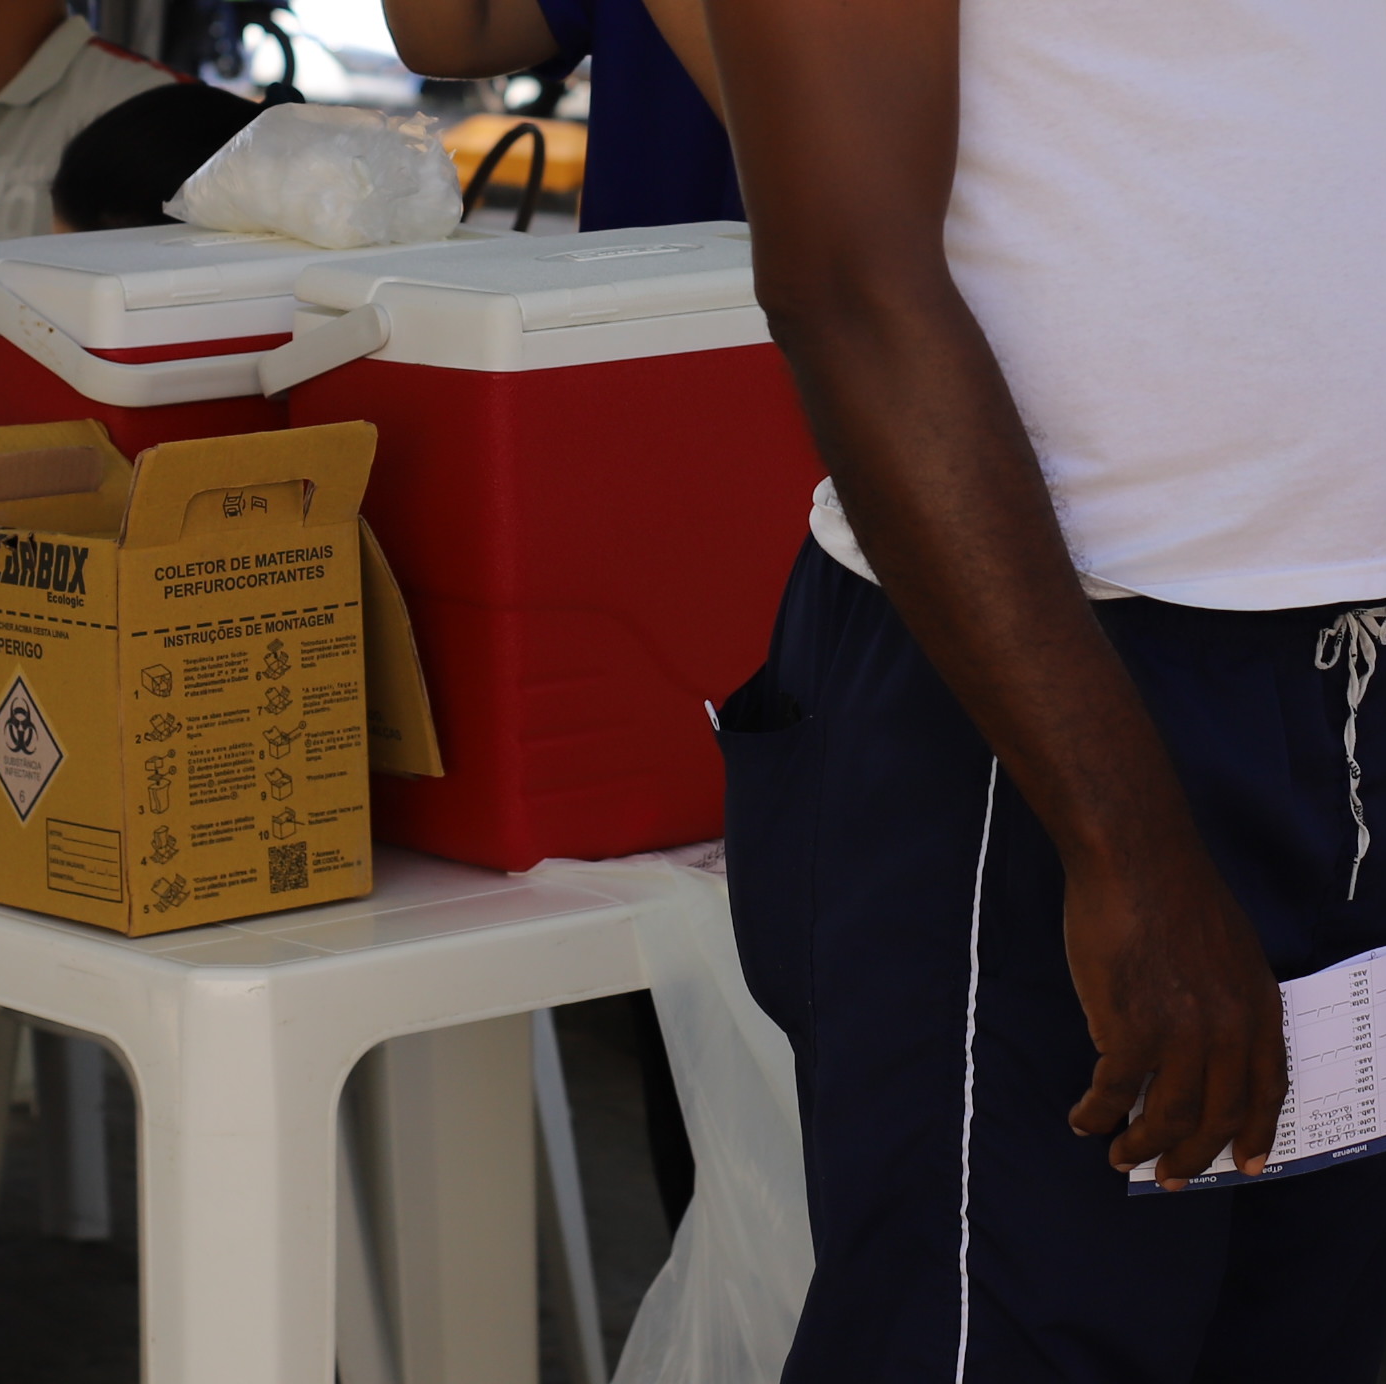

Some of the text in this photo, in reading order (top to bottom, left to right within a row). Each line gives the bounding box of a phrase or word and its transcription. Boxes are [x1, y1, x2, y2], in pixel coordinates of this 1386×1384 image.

[155, 545, 334, 581] COLETOR DE MATERIAIS
[164, 565, 325, 599] PERFUROCORTANTES
[47, 592, 85, 608] Ecologic
[14, 624, 33, 634] ACIMA
[33, 626, 51, 637] DESTA
[52, 628, 70, 640] LINHA
[164, 613, 335, 648] INSTRUÇÕES DE MONTAGEM
[256, 671, 262, 681] 6
[134, 689, 140, 700] 1
[257, 706, 263, 715] 7
[135, 734, 141, 744] 2
[259, 750, 265, 760] 8
[3, 754, 42, 770] SUBSTÂNCIA
[4, 768, 41, 782] INFECTANTE
[19, 789, 26, 803] 6
[261, 791, 267, 801] 9
[139, 805, 145, 815] 3
[259, 830, 269, 840] 10
[140, 856, 147, 867] 4
[143, 903, 150, 914] 5
[1349, 969, 1367, 979] Ass.:
[1350, 979, 1368, 988] Lab.:
[1350, 988, 1369, 998] Lote:
[1350, 998, 1370, 1007] Data:
[1352, 1014, 1370, 1023] Ass.:
[1353, 1023, 1371, 1032] Lab.:
[1353, 1032, 1372, 1042] Lote:
[1353, 1042, 1372, 1051] Data:
[1355, 1056, 1373, 1066] Ass.:
[1355, 1066, 1373, 1075] Lab.:
[1355, 1075, 1374, 1084] Lote:
[1355, 1084, 1374, 1094] Data:
[1357, 1099, 1375, 1107] Ass.:
[1280, 1107, 1295, 1116] Dat
[1358, 1107, 1376, 1117] Lab.:
[1358, 1116, 1376, 1126] Lote:
[1357, 1125, 1376, 1136] Data:
[1276, 1139, 1296, 1148] Lote:
[1276, 1147, 1296, 1156] Data:
[1332, 1144, 1367, 1158] Influenza
[1262, 1164, 1283, 1174] dTpa
[1189, 1176, 1217, 1184] Outras
